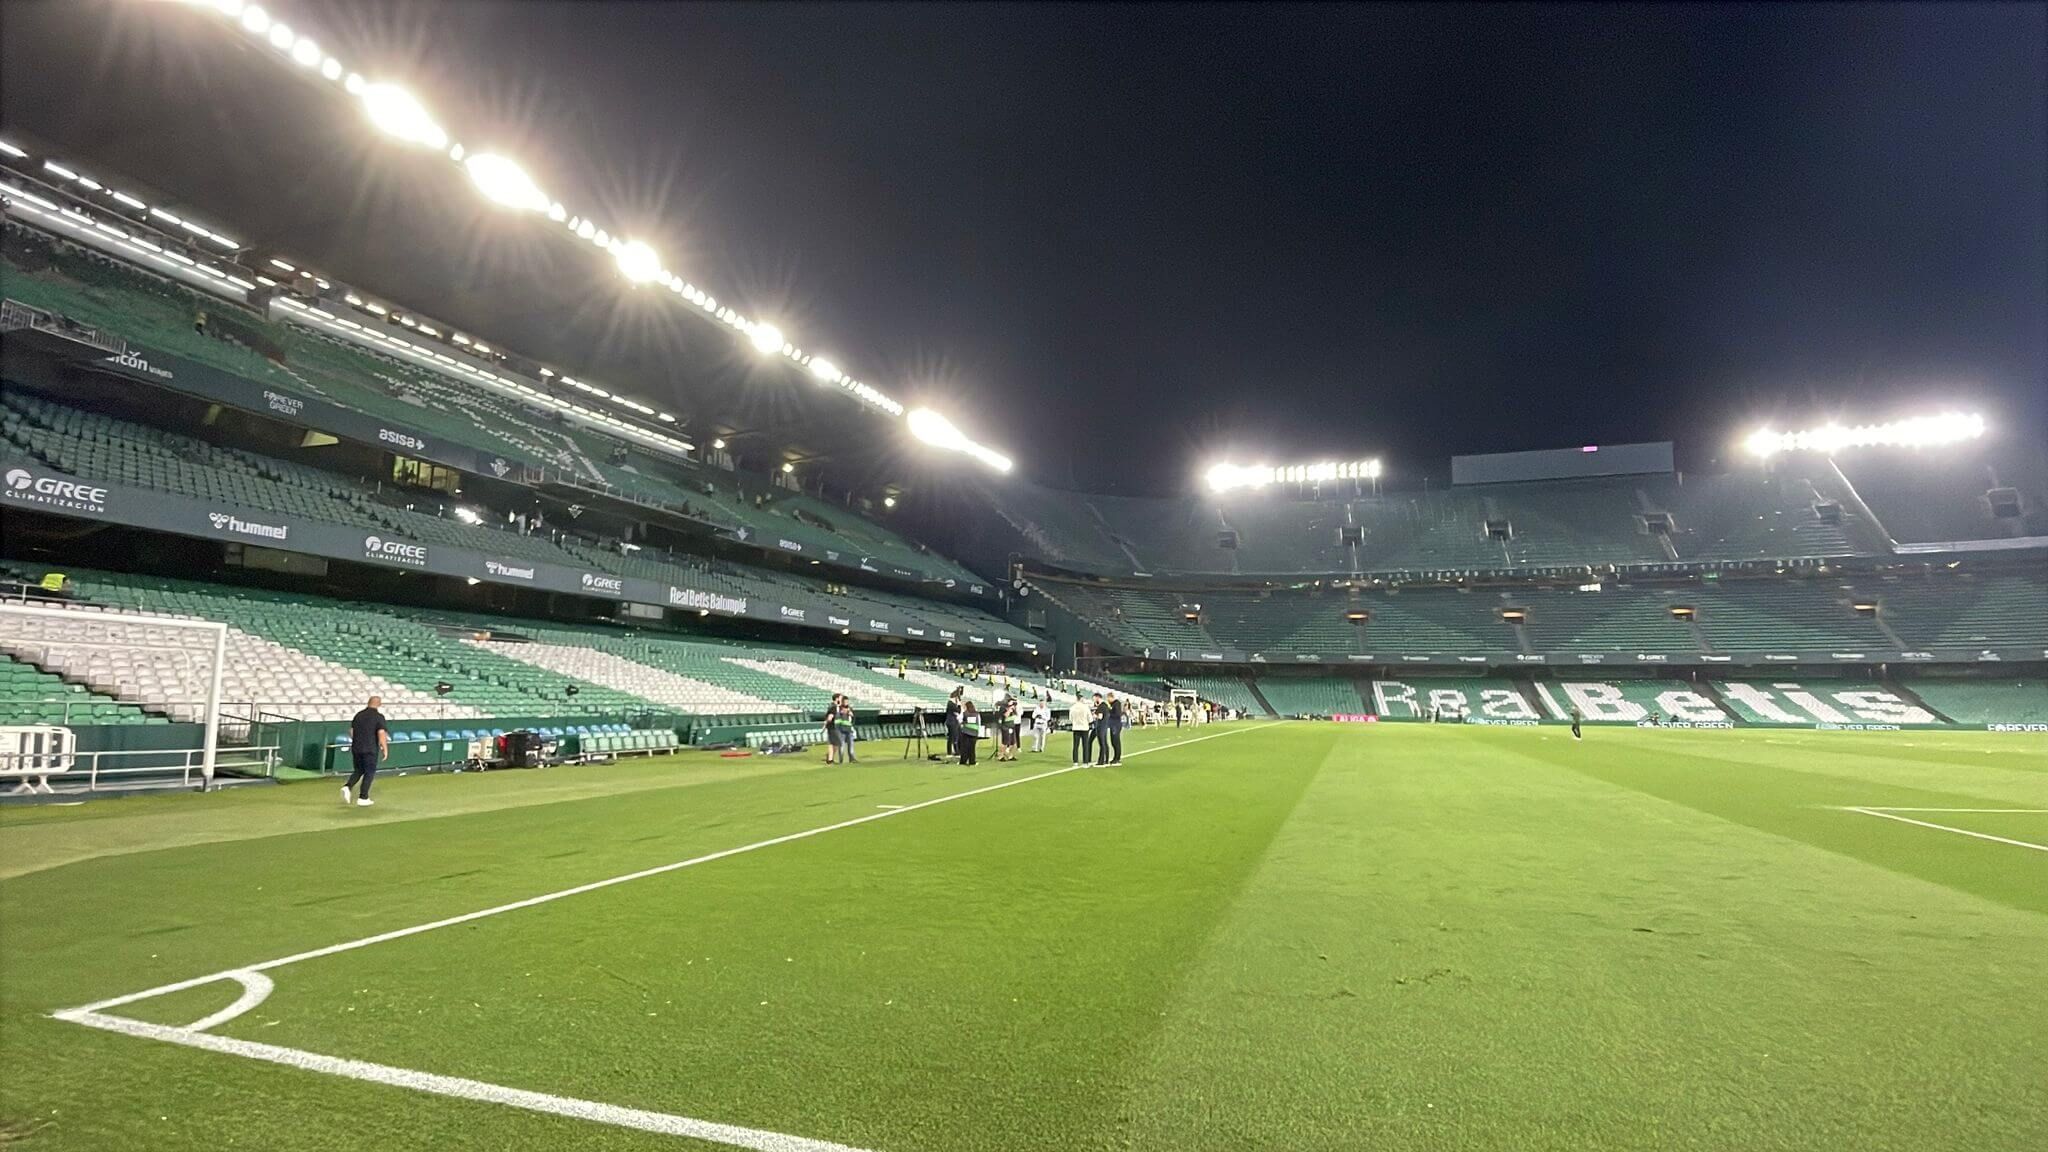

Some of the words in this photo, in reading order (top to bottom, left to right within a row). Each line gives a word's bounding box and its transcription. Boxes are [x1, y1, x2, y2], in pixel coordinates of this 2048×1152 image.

[34, 477, 108, 504] GREE
[228, 515, 287, 540] hummel
[382, 541, 427, 560] GREE
[593, 576, 622, 590] GREE
[669, 586, 689, 605] Real
[688, 588, 710, 609] Betis
[787, 607, 805, 618] GREE
[1564, 682, 1941, 724] Betis
[1987, 723, 2048, 732] FOREVER
